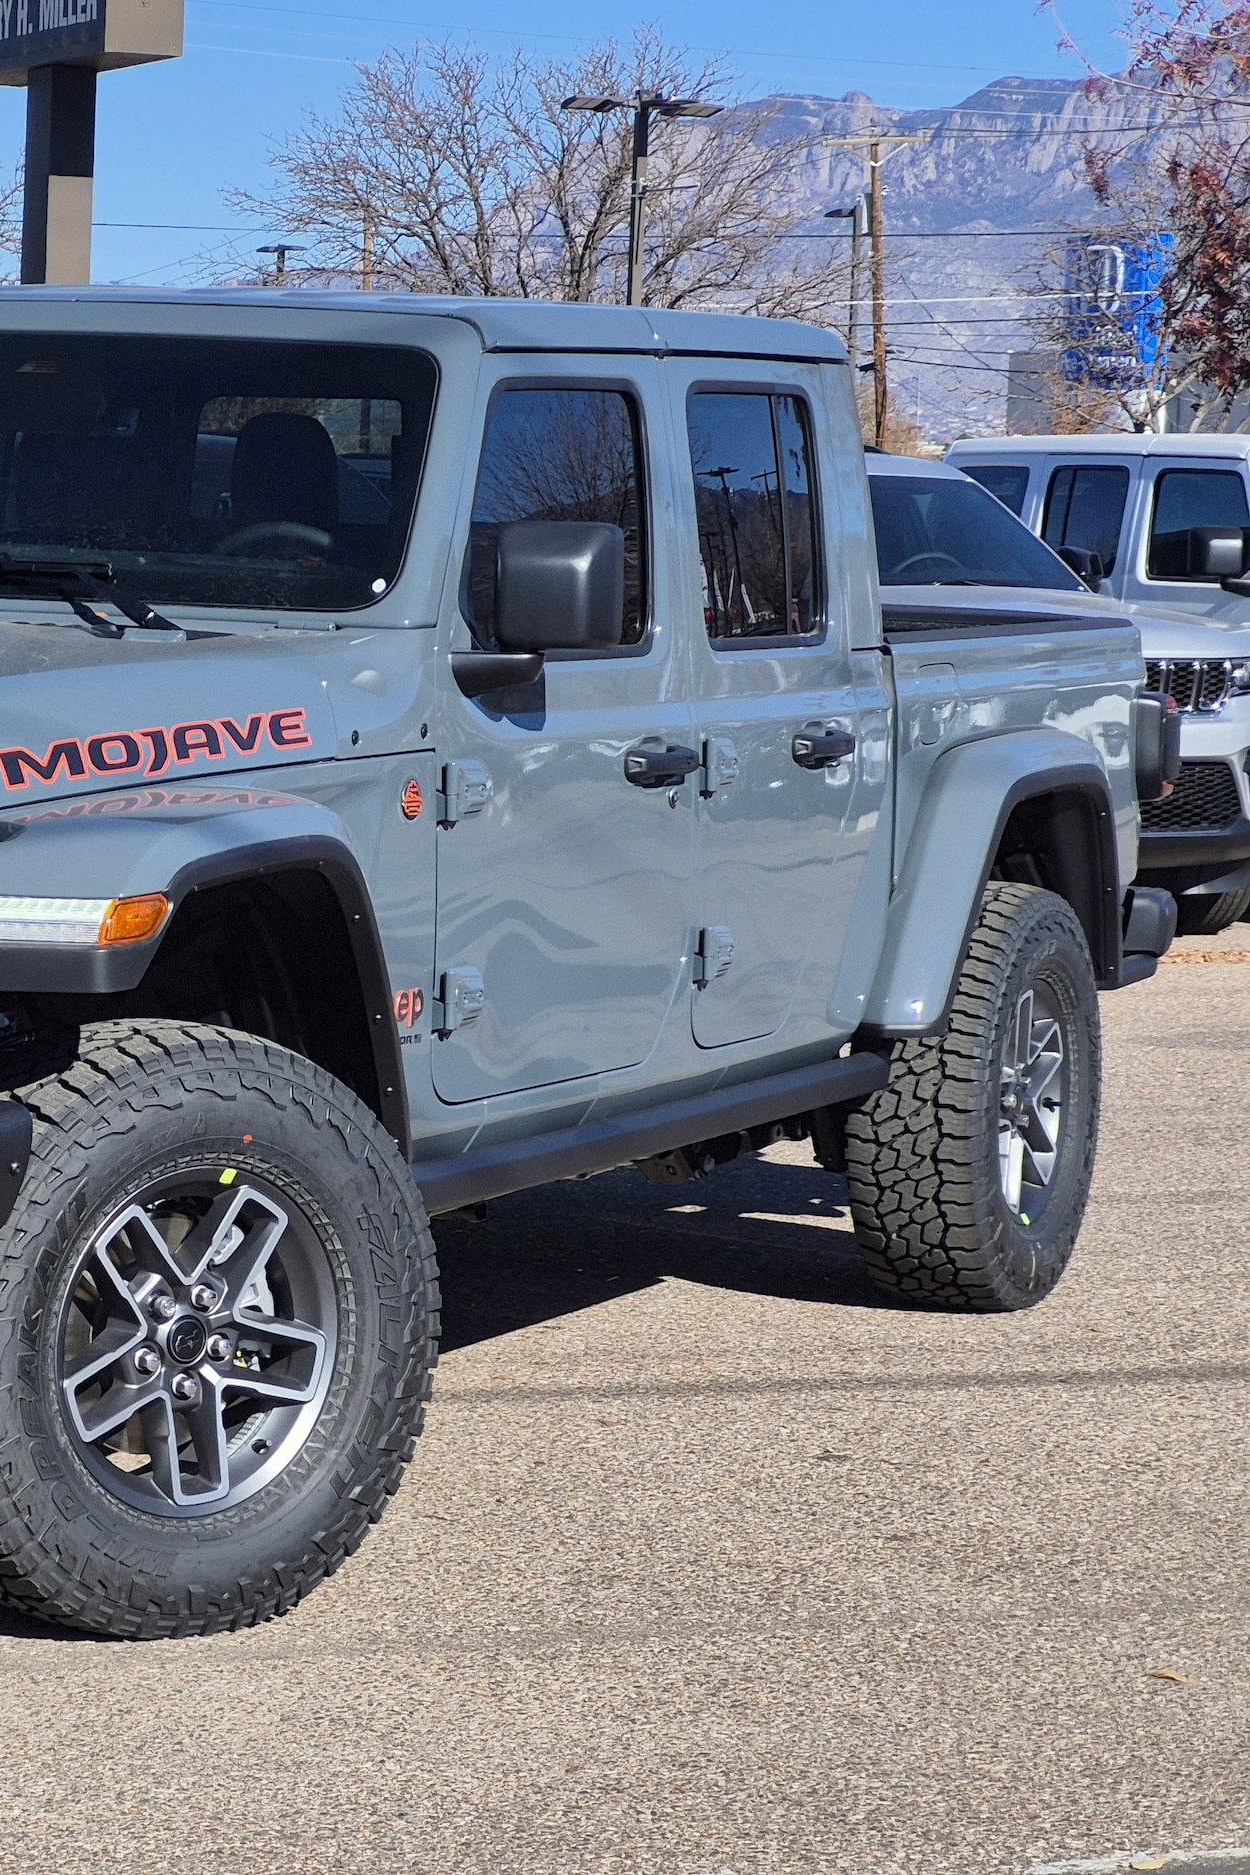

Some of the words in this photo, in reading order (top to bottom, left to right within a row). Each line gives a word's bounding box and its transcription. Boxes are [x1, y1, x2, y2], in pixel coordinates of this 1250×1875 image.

[16, 0, 34, 36] H.
[39, 0, 98, 31] MILLER
[329, 1203, 403, 1500] FALKEN
